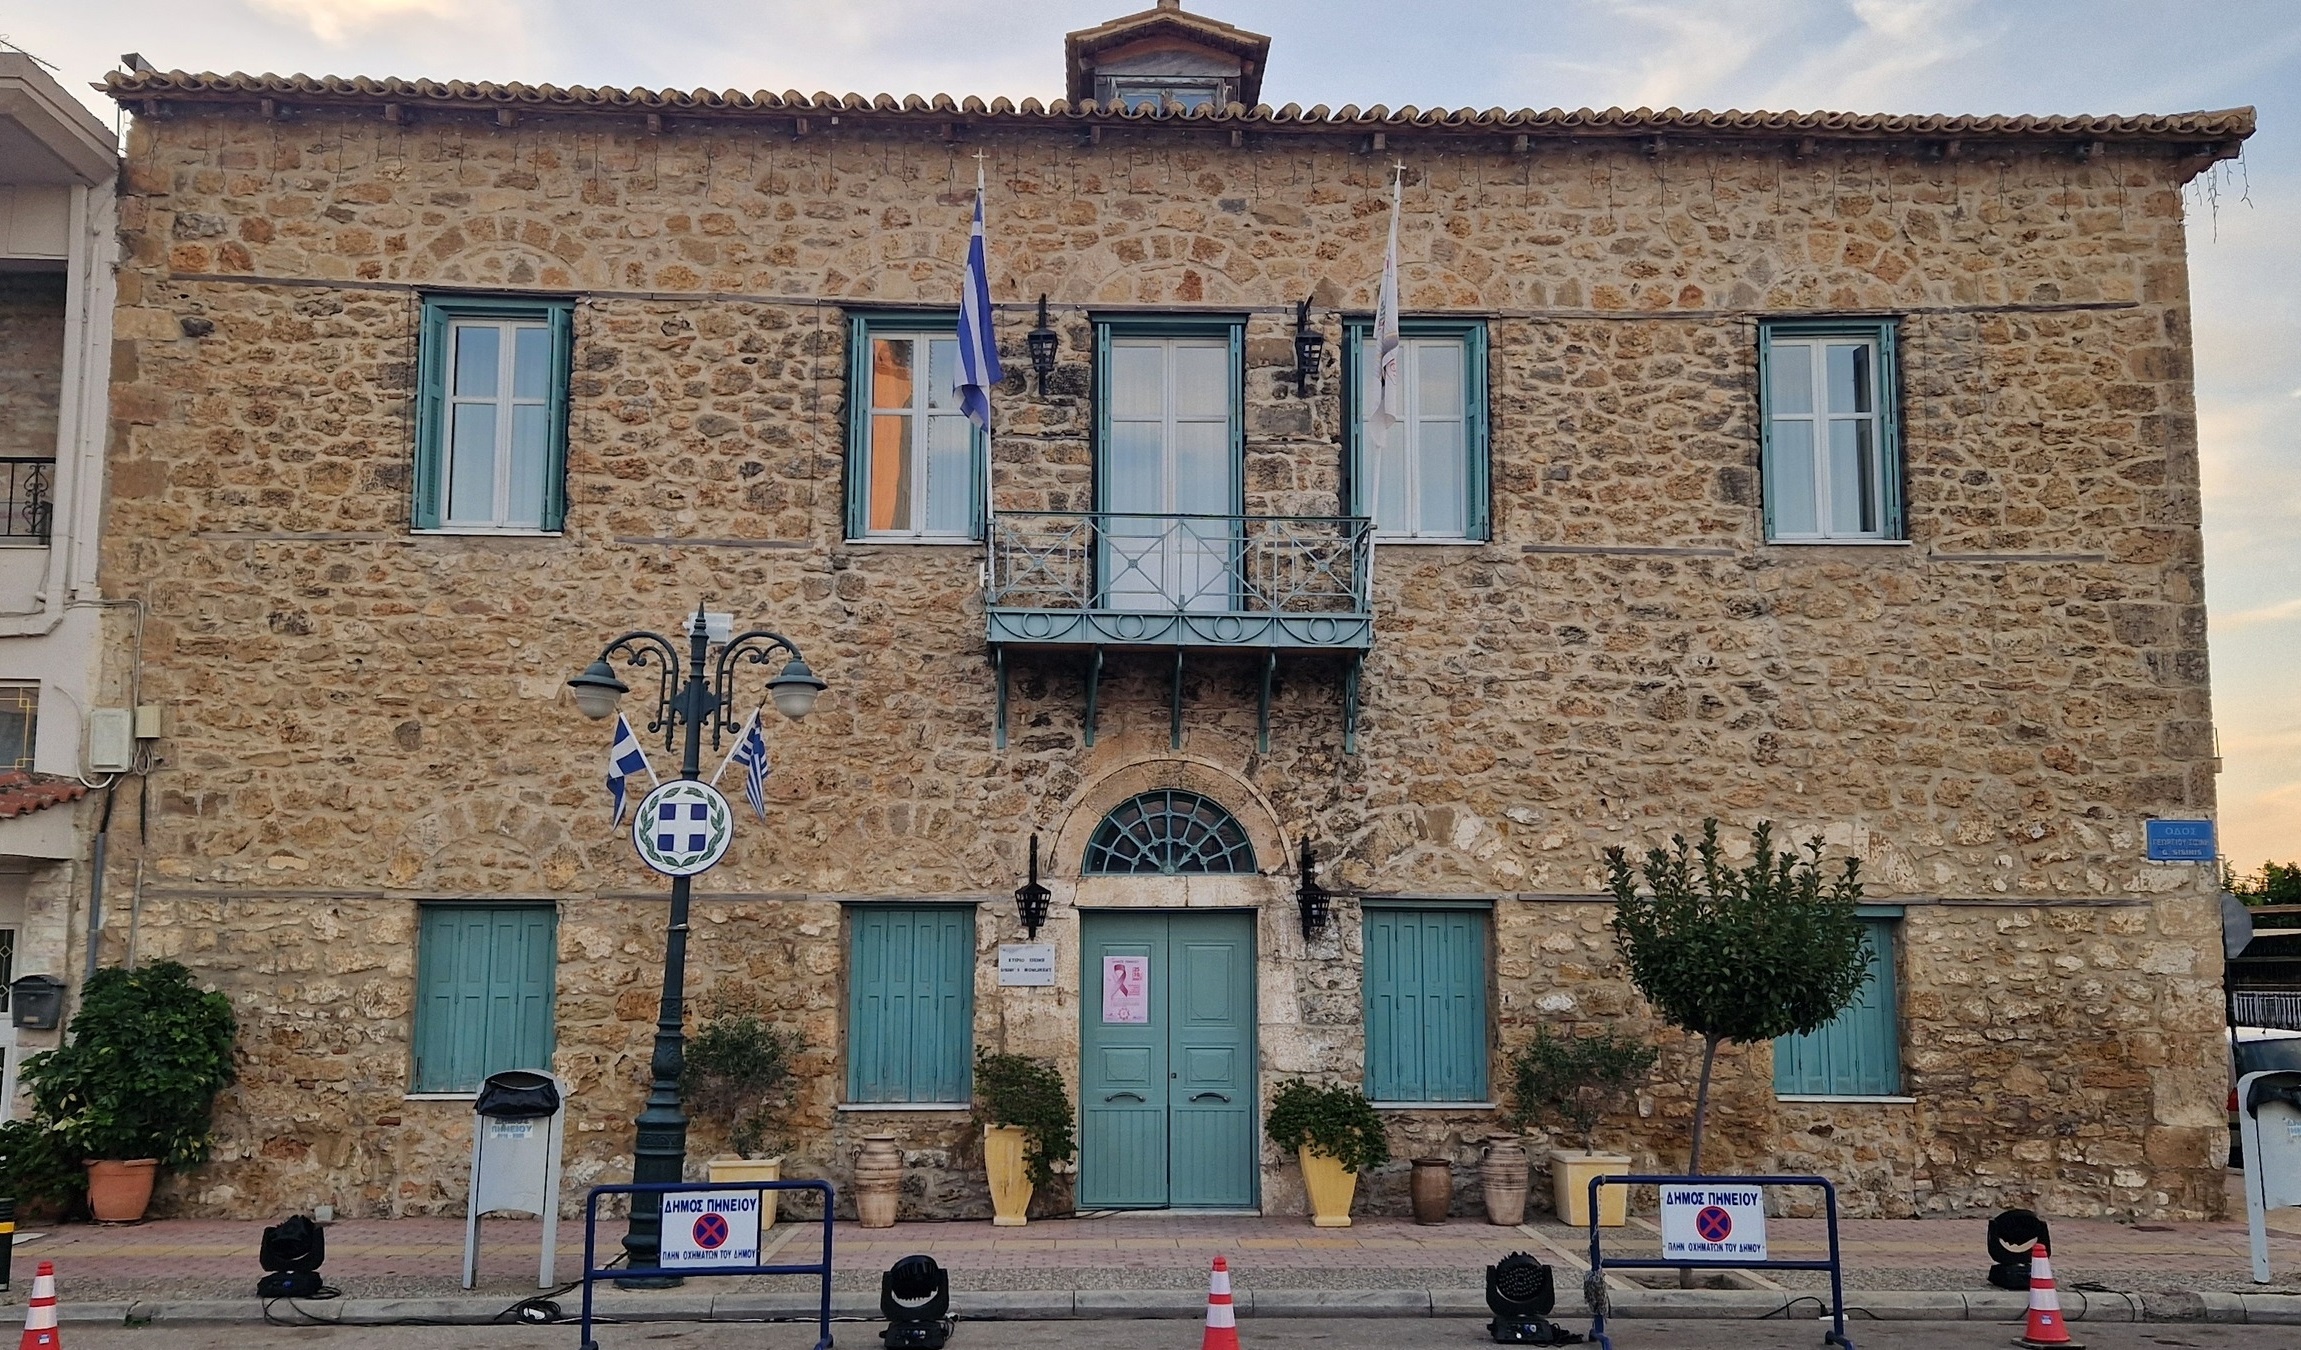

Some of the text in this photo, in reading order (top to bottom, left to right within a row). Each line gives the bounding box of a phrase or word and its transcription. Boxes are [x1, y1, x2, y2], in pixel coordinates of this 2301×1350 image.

[2165, 827, 2196, 835] ΟΔΟΣ
[1666, 1191, 1758, 1206] ΔΗΜΟΣ ΠΗΝΕΙΟΥ
[664, 1198, 757, 1213] ΔΗΜΟΣ ΠΗΝΕΙΟΥ
[1668, 1242, 1761, 1253] ΠΛΗΝ ΟΧΗΜΑΤΩΝ ΤΟΥ ΔΗΜΟΥ
[662, 1249, 756, 1260] ΠΛΗΝ ΟΧΗΜΑΤΩΝ ΤΟΥ ΔΗΜΟΥ
